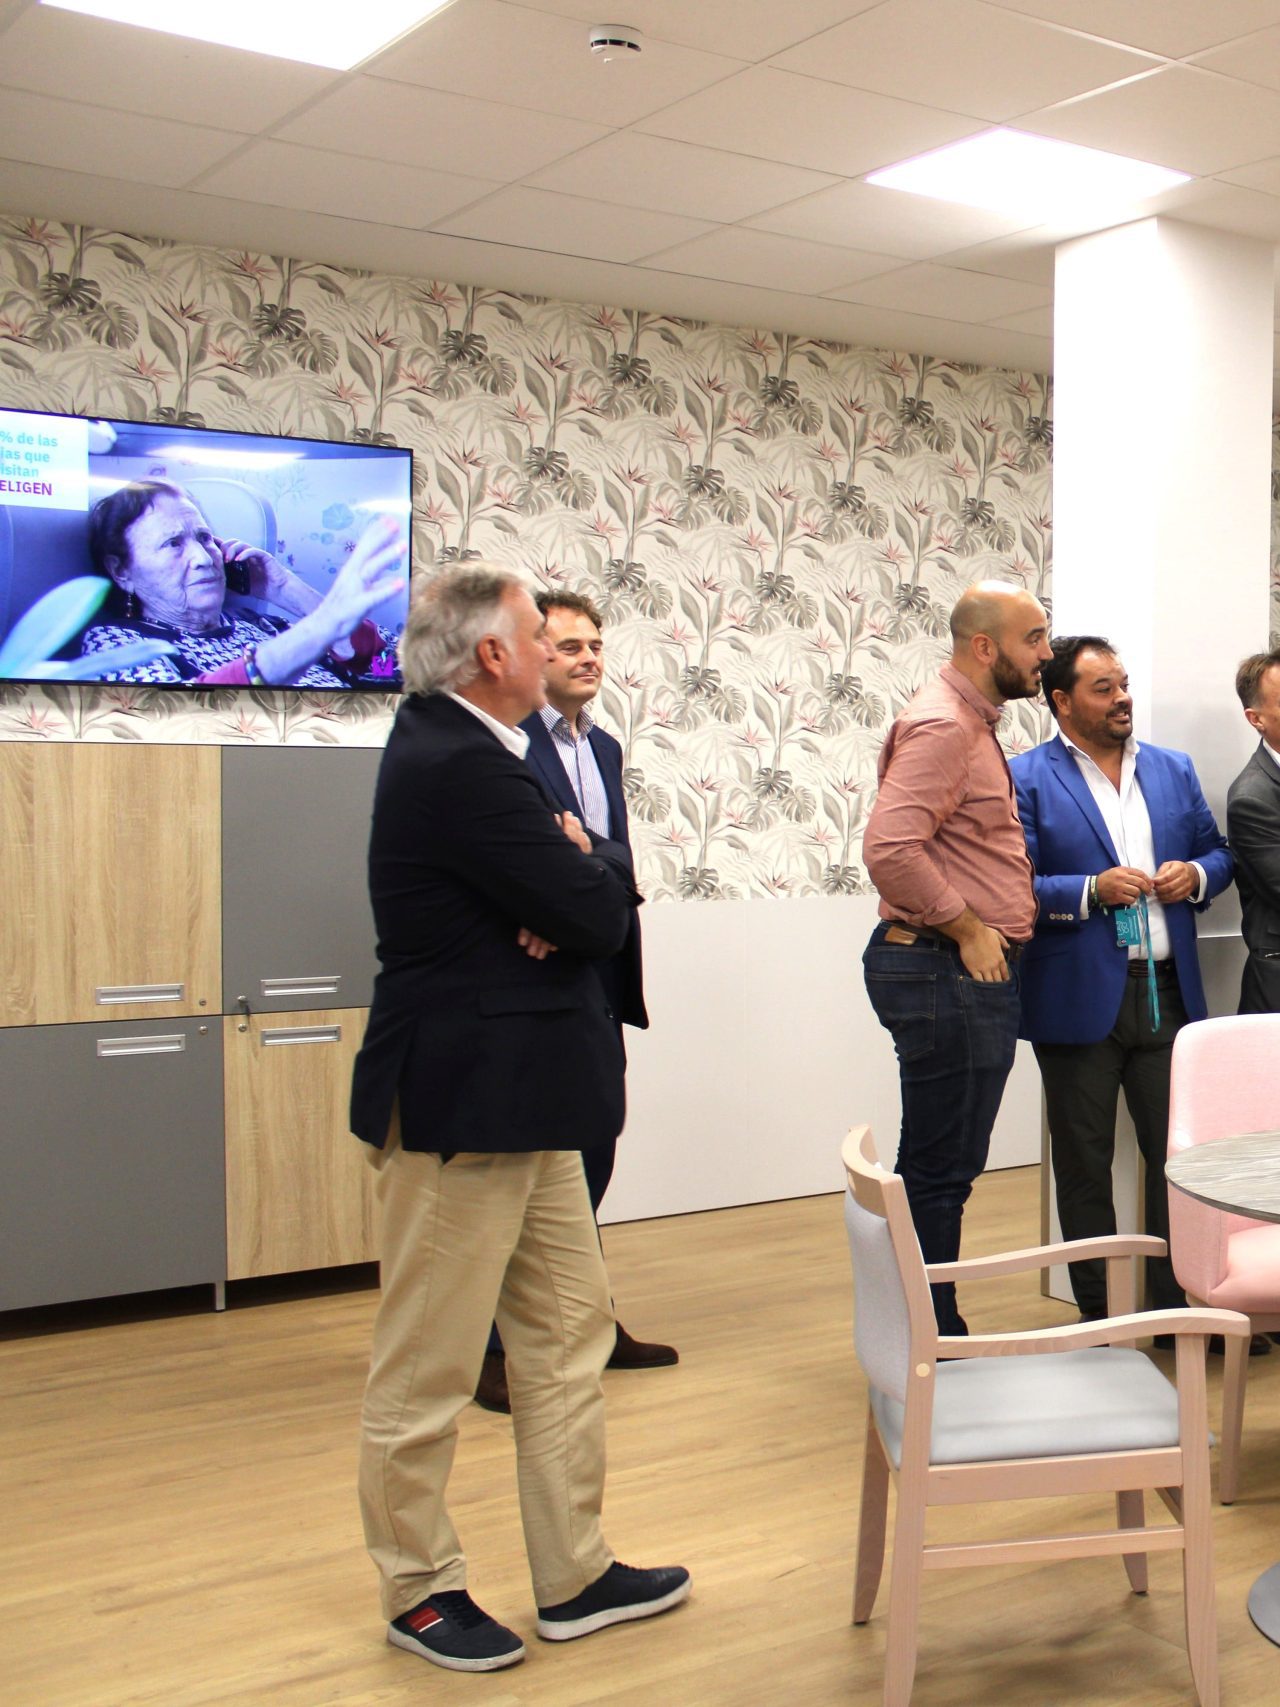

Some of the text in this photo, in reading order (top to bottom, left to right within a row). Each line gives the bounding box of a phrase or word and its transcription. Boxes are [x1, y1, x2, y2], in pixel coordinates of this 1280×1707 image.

[17, 432, 34, 445] de
[38, 434, 58, 447] las
[25, 449, 50, 463] que
[0, 480, 52, 496] ELIGEN
